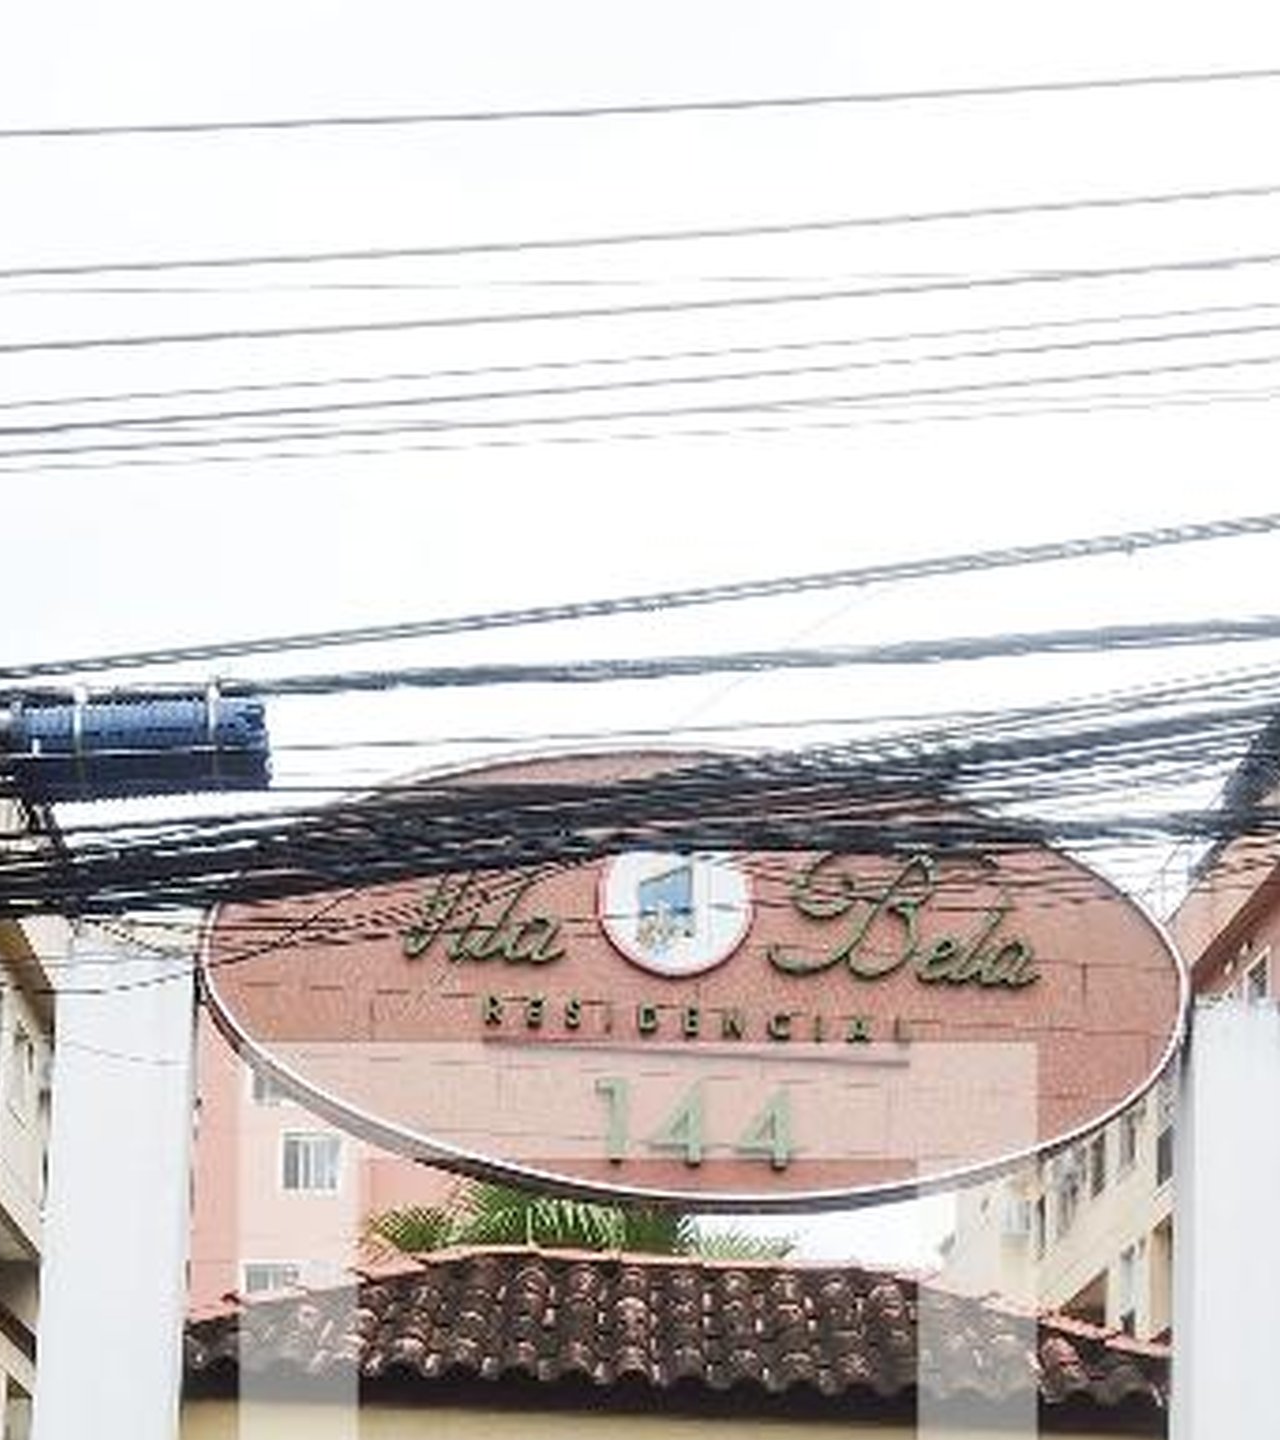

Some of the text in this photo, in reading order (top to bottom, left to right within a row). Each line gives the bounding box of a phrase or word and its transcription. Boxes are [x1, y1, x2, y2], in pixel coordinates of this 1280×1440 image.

[767, 850, 1041, 988] Bela
[483, 996, 910, 1048] RESIDENCIAL
[595, 1074, 806, 1170] 144
